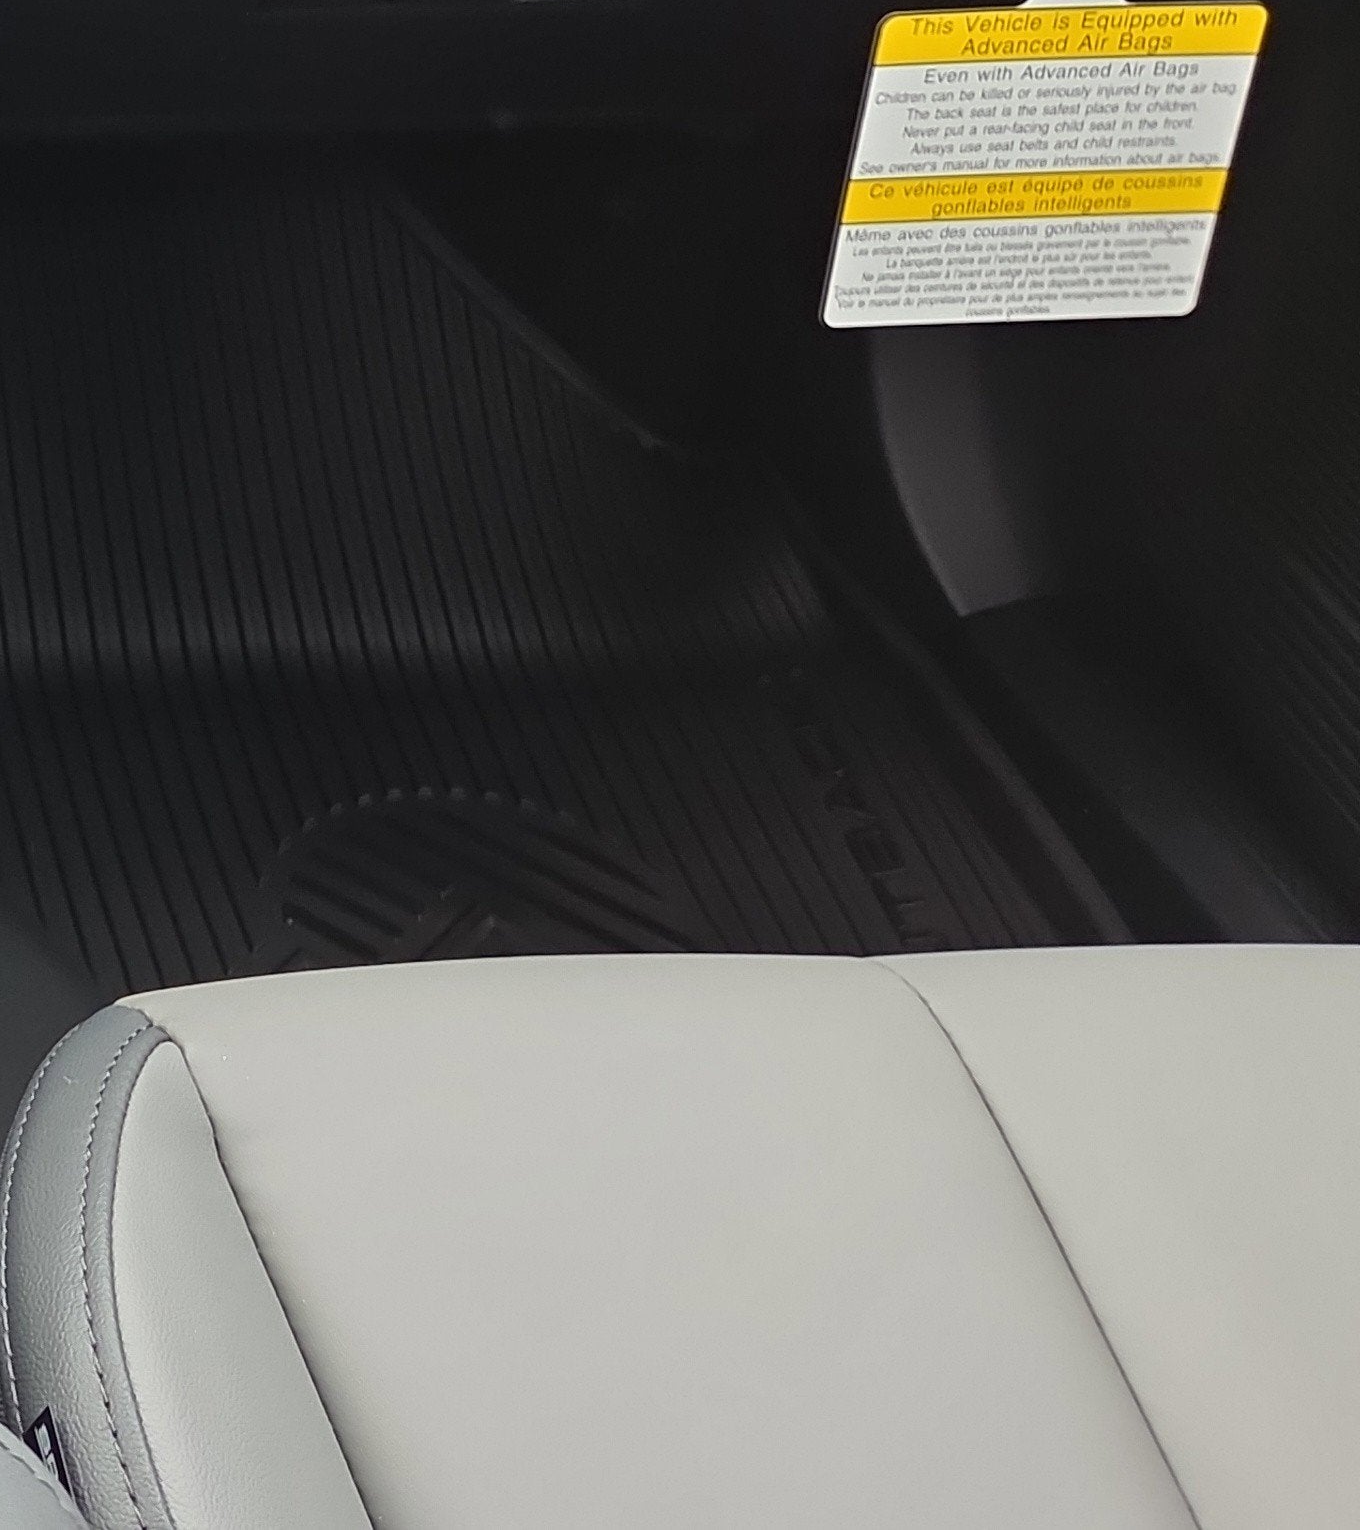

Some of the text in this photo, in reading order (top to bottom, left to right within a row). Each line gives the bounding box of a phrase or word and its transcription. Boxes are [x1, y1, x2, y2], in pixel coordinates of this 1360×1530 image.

[912, 9, 1237, 36] This Vehicle is Equipped with
[961, 32, 1173, 55] Advanced Air Bags
[924, 60, 1199, 84] Even with Advanced Air Bags
[869, 183, 895, 199] Ce
[986, 179, 1014, 194] est
[1092, 176, 1114, 191] de
[1123, 174, 1203, 190] coussins
[931, 194, 1131, 217] gonflables intelligents
